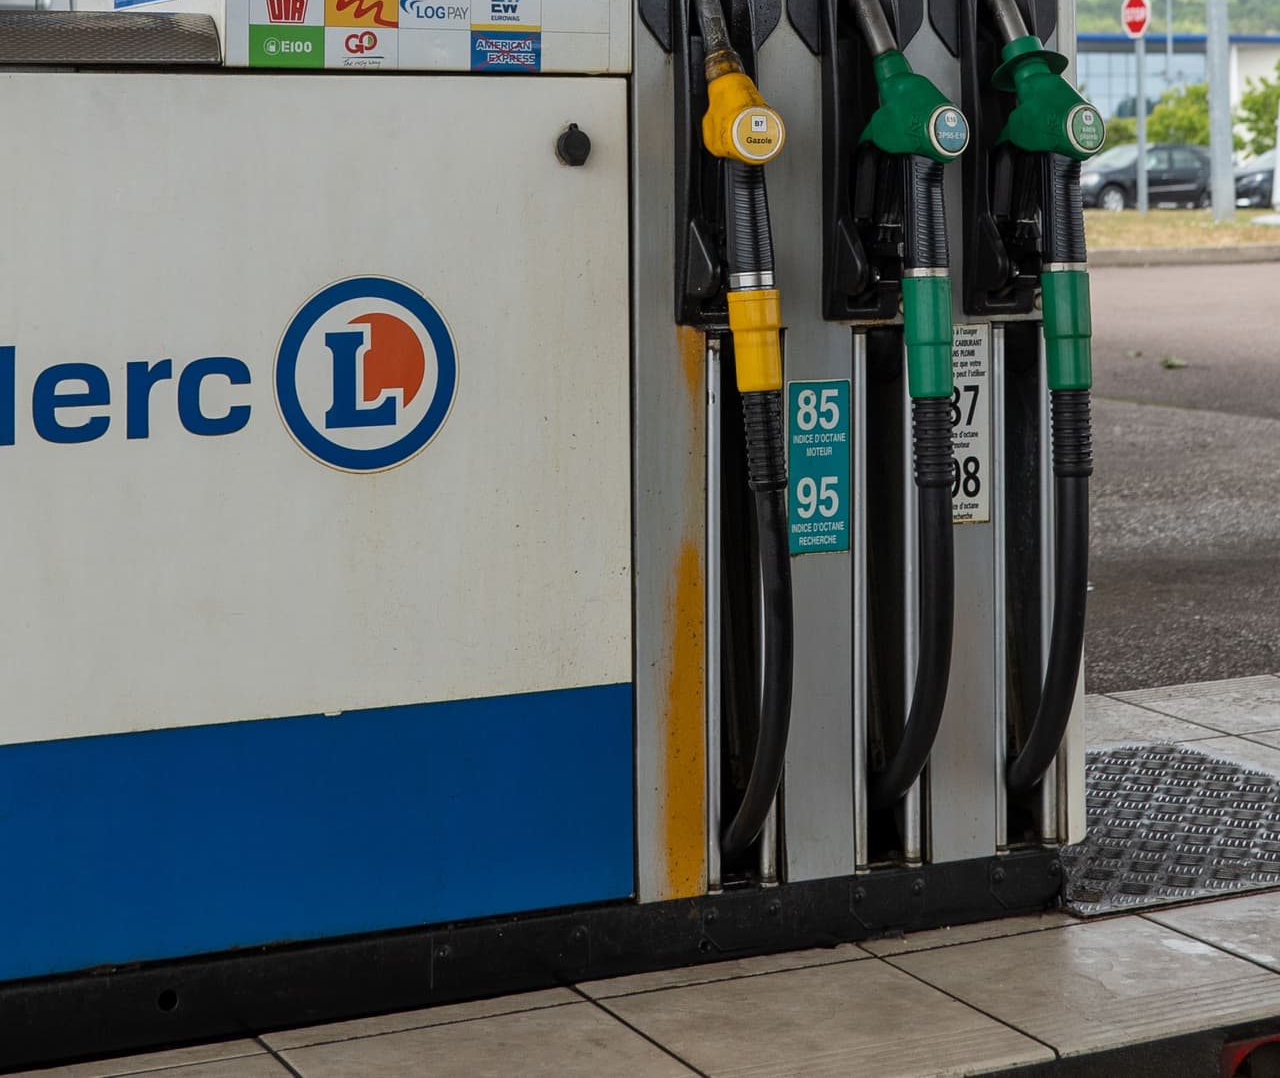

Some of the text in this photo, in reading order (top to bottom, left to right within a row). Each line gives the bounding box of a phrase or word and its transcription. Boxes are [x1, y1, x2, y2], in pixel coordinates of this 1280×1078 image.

[281, 40, 312, 53] E100
[345, 31, 377, 54] GO
[476, 39, 532, 51] AMERICAN
[487, 53, 536, 64] EXPRESS
[746, 136, 772, 144] Gazole
[955, 339, 982, 347] CARBURANT
[960, 349, 975, 357] PLOMB
[796, 388, 840, 431] 85
[793, 432, 846, 444] INDICE D'OCTANE
[806, 446, 833, 457] MOTEUR
[796, 476, 840, 518] 95
[792, 521, 845, 533] INDICE D'OCTANE
[799, 535, 837, 546] RECHERCHE
